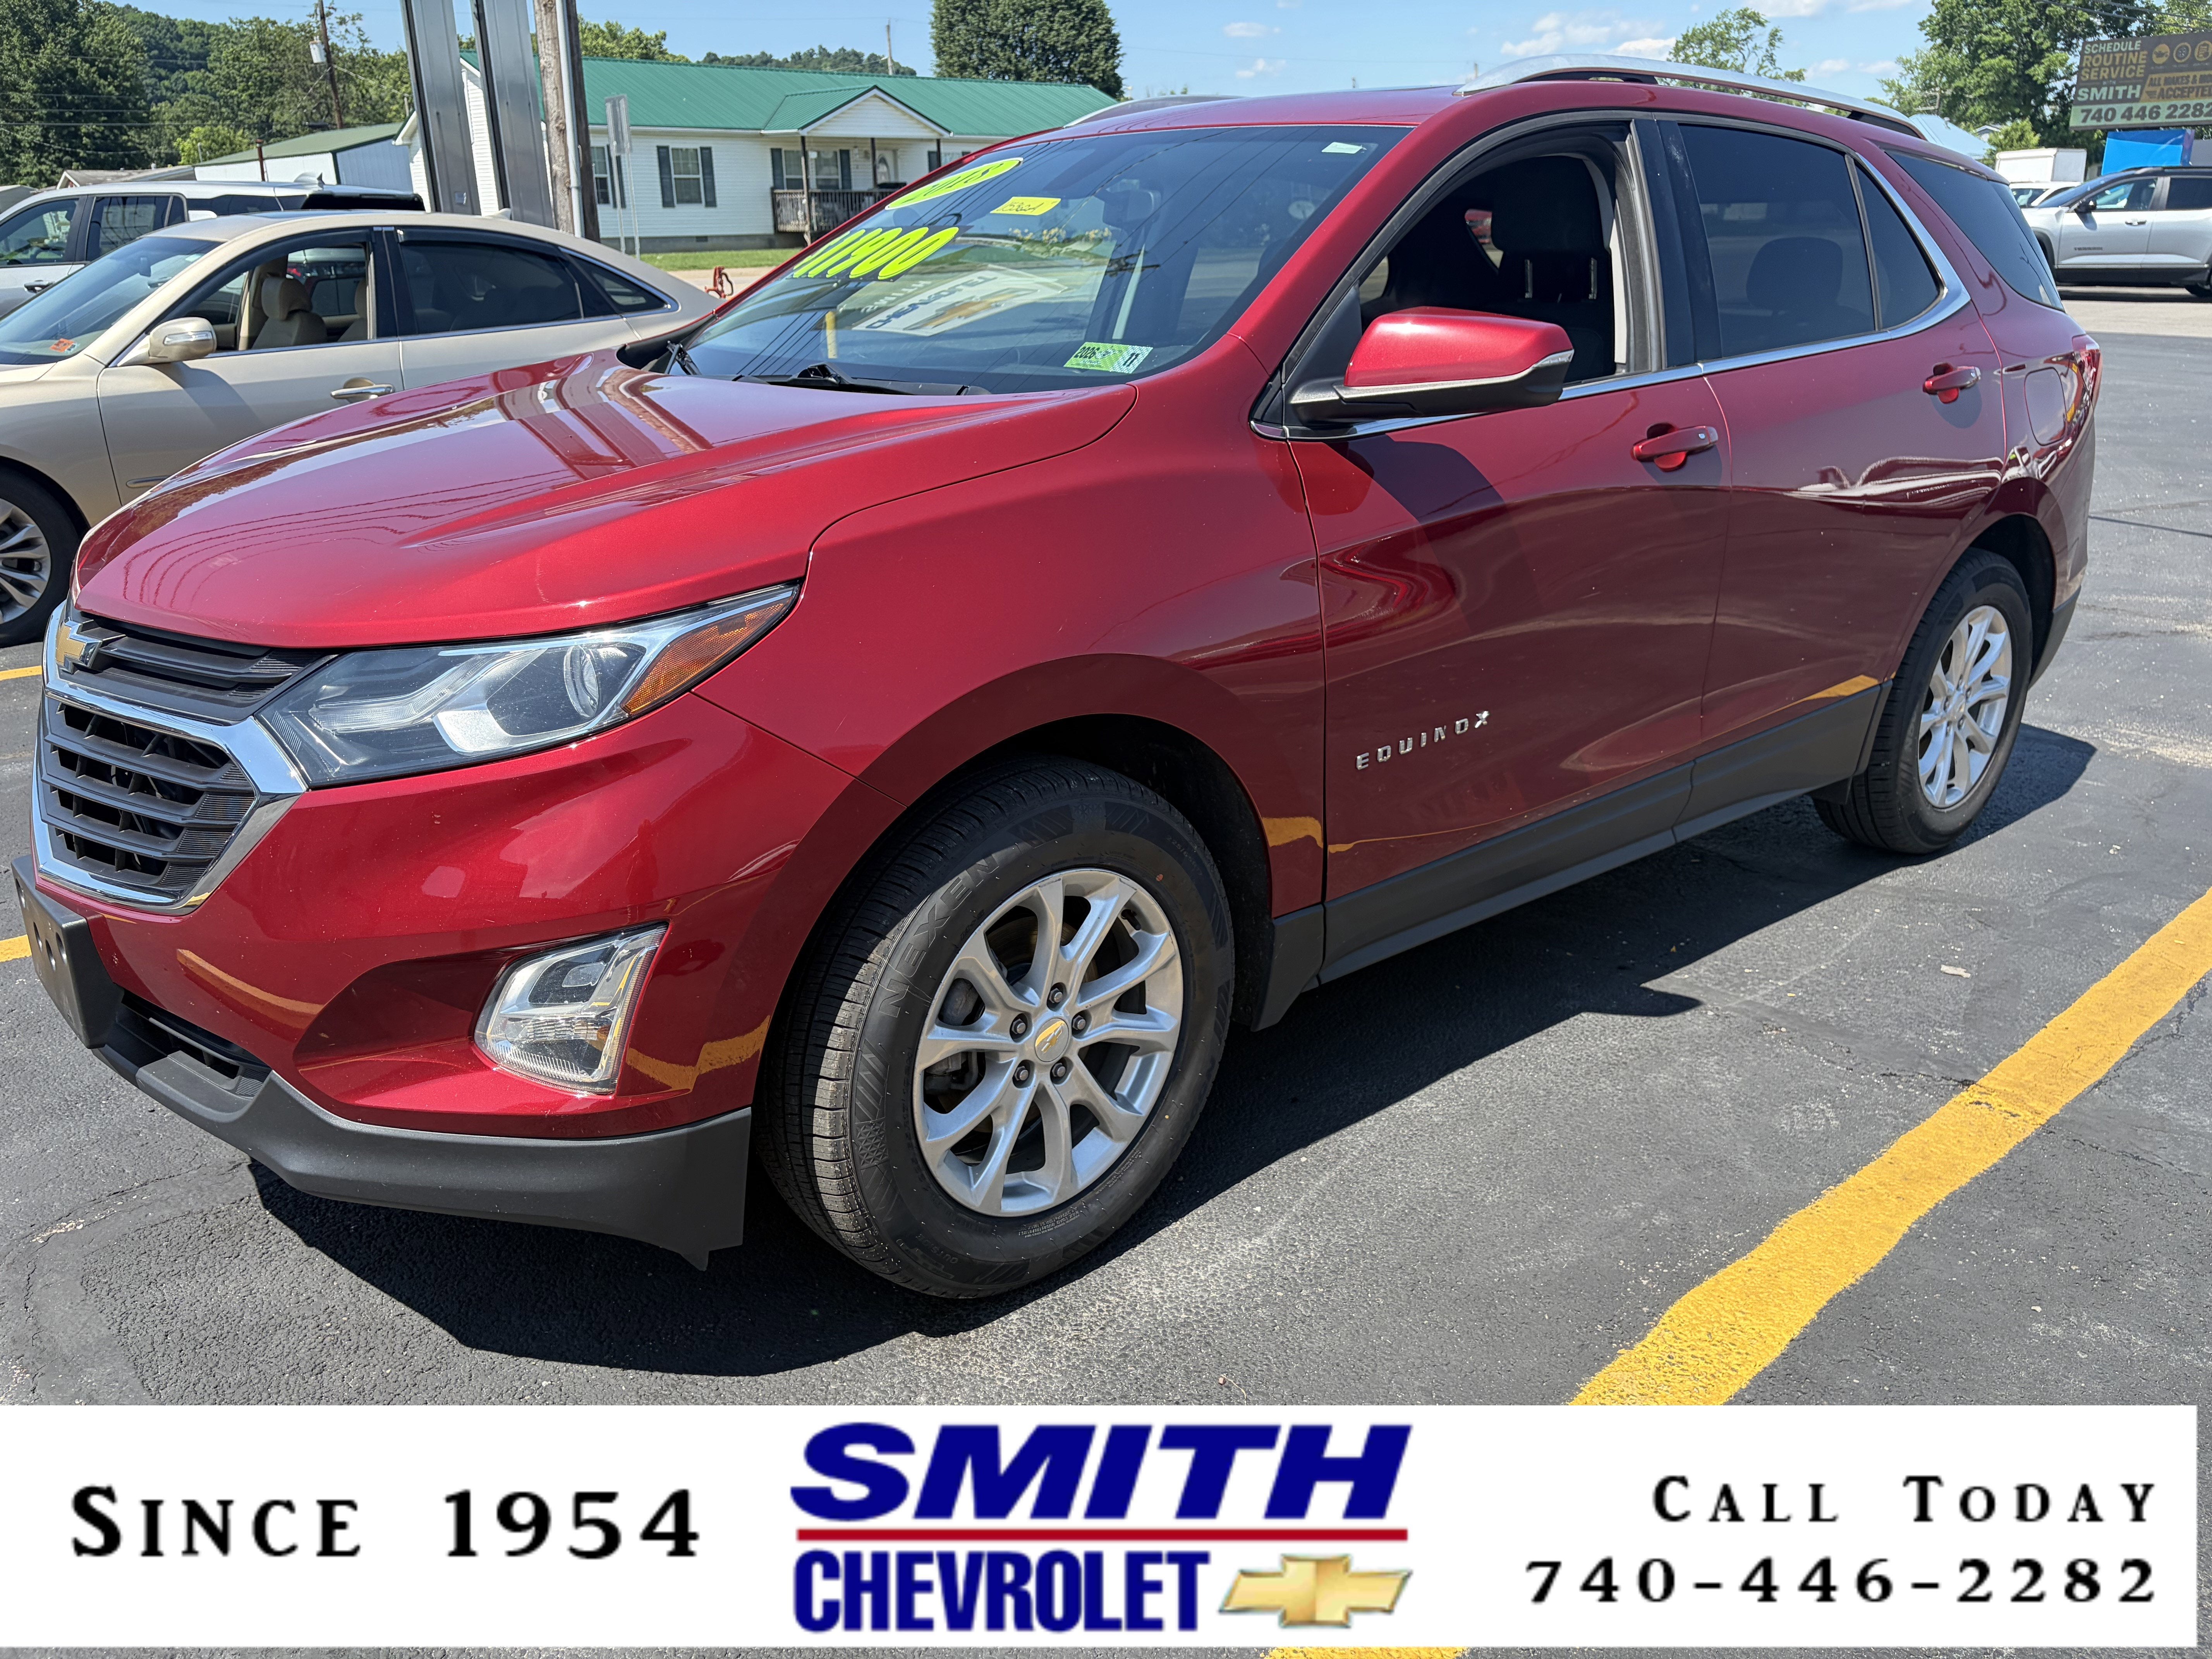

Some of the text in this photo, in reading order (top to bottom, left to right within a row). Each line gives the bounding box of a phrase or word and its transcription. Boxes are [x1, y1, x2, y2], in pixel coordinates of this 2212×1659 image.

[2084, 40, 2141, 54] SCHEDULE
[2083, 51, 2148, 67] ROUTINE
[2081, 65, 2145, 81] SERVICE
[2077, 84, 2141, 101] SMITH
[2081, 102, 2212, 123] 740 446 2282
[1073, 346, 1141, 367] 2026 11
[1356, 711, 1490, 770] EQUINOX
[879, 854, 999, 1018] NEXEN
